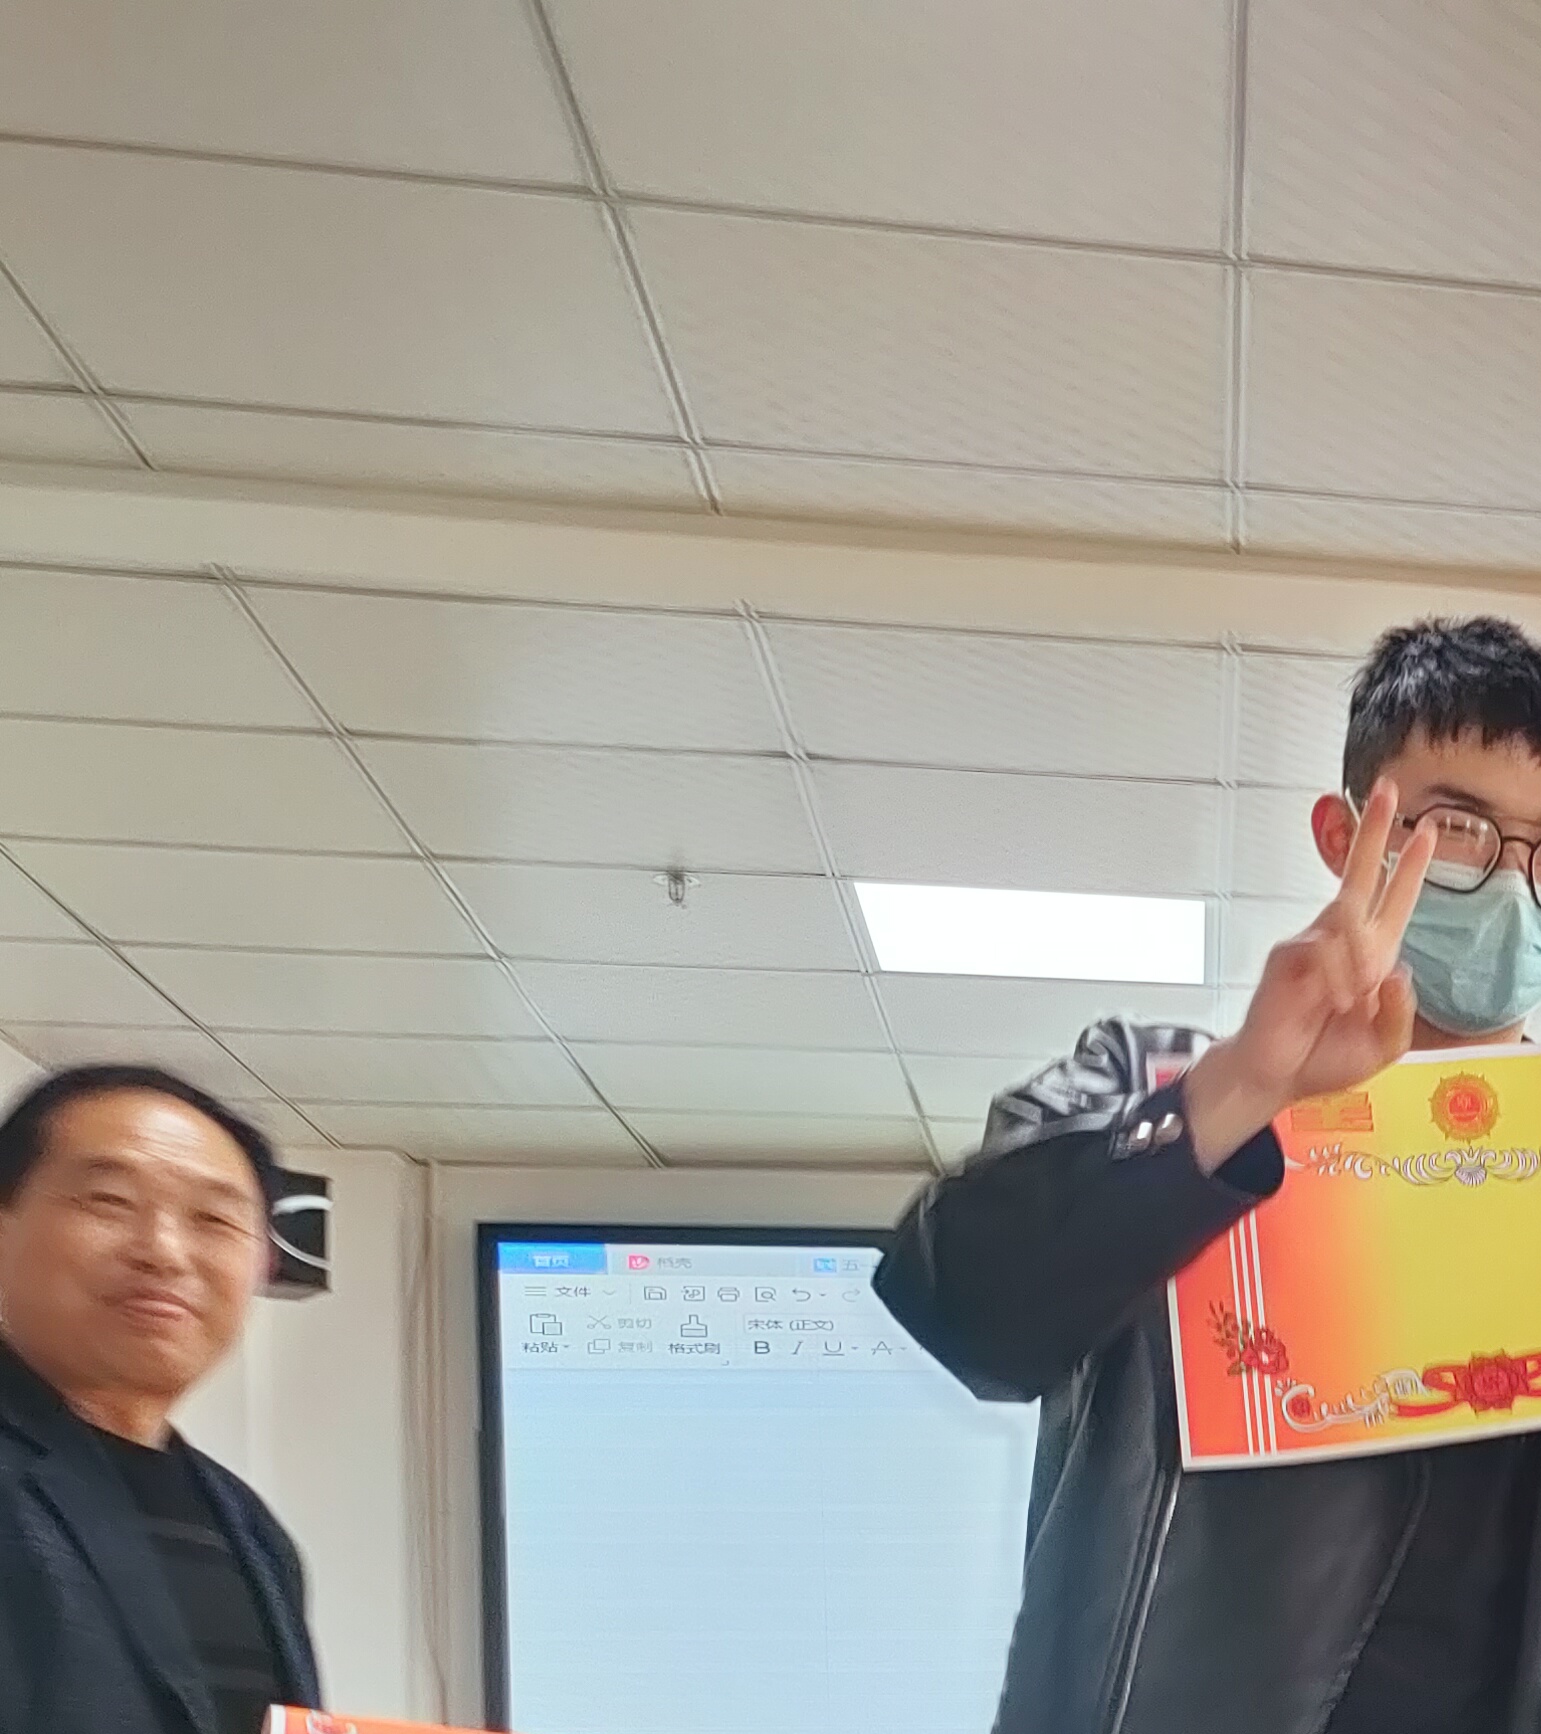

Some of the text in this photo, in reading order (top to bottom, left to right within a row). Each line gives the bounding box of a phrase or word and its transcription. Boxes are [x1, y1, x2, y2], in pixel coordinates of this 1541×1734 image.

[555, 1286, 591, 1298] 文件
[617, 1317, 653, 1330] 剪切
[521, 1341, 558, 1354] 粘贴
[618, 1341, 653, 1354] 复制
[667, 1341, 721, 1355] 格式刷
